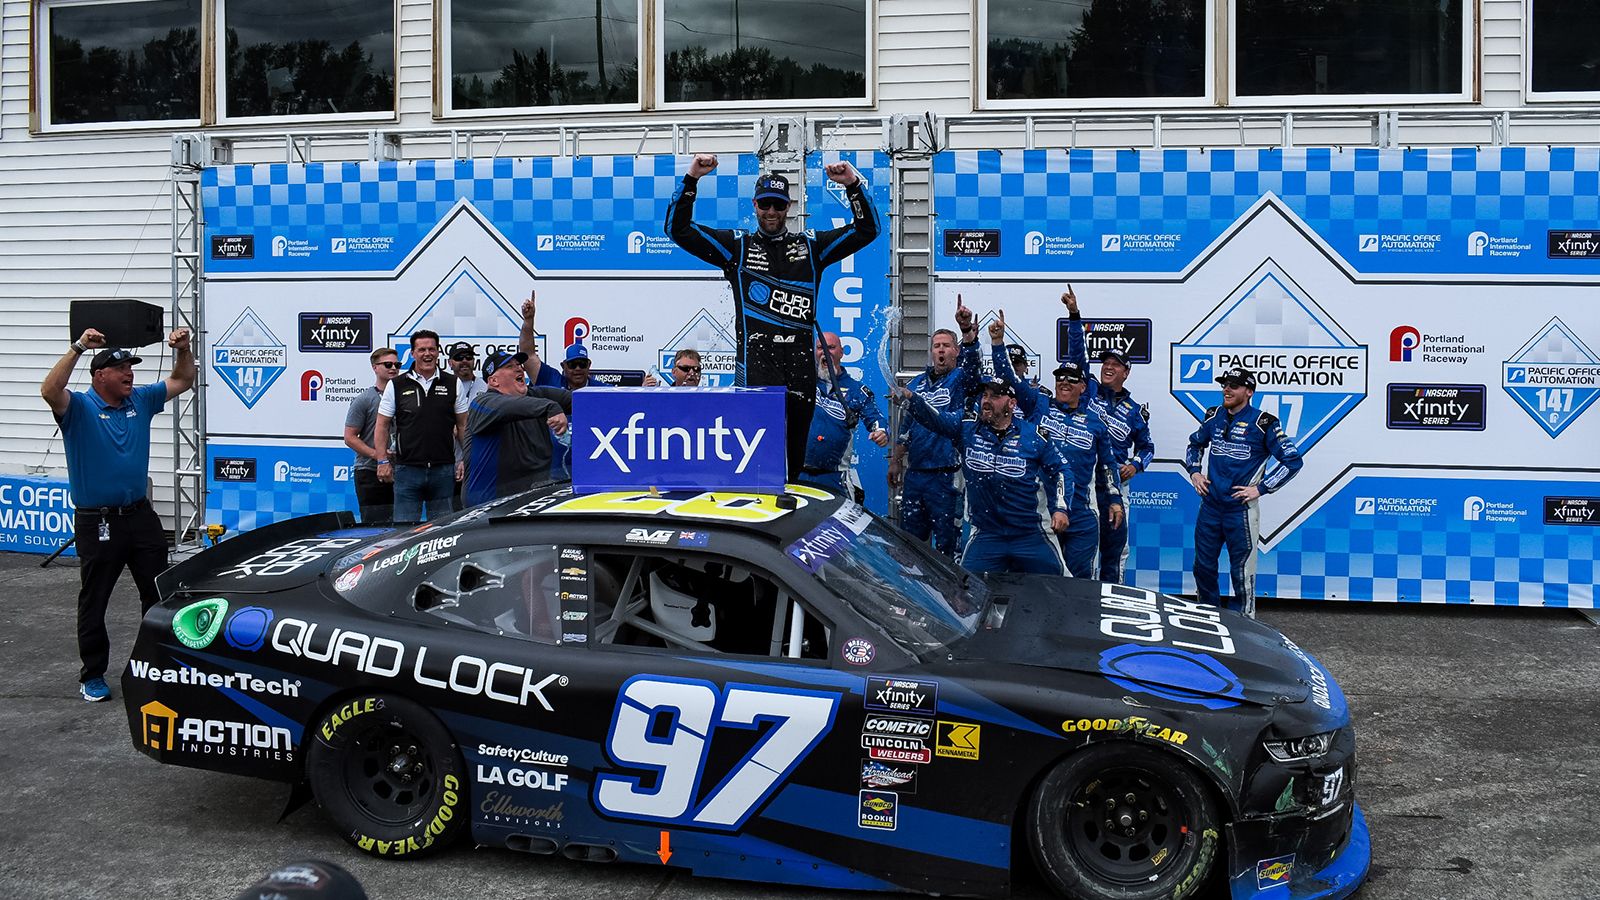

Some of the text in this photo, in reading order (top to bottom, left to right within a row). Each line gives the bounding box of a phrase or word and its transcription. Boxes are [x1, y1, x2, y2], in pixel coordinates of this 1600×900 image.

[218, 242, 248, 254] xfinity
[954, 238, 991, 252] xfinity
[1558, 239, 1599, 254] xfinity
[772, 290, 810, 308] QUAD
[770, 299, 808, 320] LOCK
[310, 325, 360, 344] xfinity
[1423, 335, 1464, 343] Portland
[592, 344, 630, 352] Raceway
[1086, 333, 1135, 353] finity
[1423, 345, 1484, 353] International
[1219, 354, 1358, 369] PACIFIC OFFICE
[1423, 354, 1468, 364] Raceway
[236, 368, 262, 387] 147
[1529, 376, 1595, 384] AUTOMATION
[1425, 389, 1458, 398] NASCAR
[1536, 389, 1574, 412] 147
[1404, 398, 1469, 420] xfinity
[589, 412, 766, 474] xfinity
[220, 465, 249, 477] xfinity
[1554, 505, 1595, 520] xfinity
[626, 528, 675, 542] SVG
[800, 526, 849, 560] xfinity
[417, 553, 450, 565] PROTECTION
[1100, 583, 1165, 642] QUAD
[271, 617, 405, 678] QUAD
[848, 640, 871, 650] NASCAR
[876, 687, 925, 707] xfinity
[322, 698, 375, 741] EAGLE
[866, 719, 930, 734] COMETIC
[178, 718, 292, 750] ACTION
[865, 737, 919, 750] LINCOLN
[182, 743, 293, 762] INDUSTRIES
[478, 744, 568, 764] SafetyCulture
[596, 677, 839, 828] 97
[877, 750, 924, 761] WELDERS
[937, 748, 977, 759] KENNAMETAL
[477, 765, 568, 791] LA GOLF
[480, 790, 564, 821] Ellsworth
[864, 800, 893, 809] SUNOCO
[484, 814, 561, 828] ADVISORS
[862, 814, 893, 822] ROOKIE
[1260, 863, 1292, 878] SUNOCO
